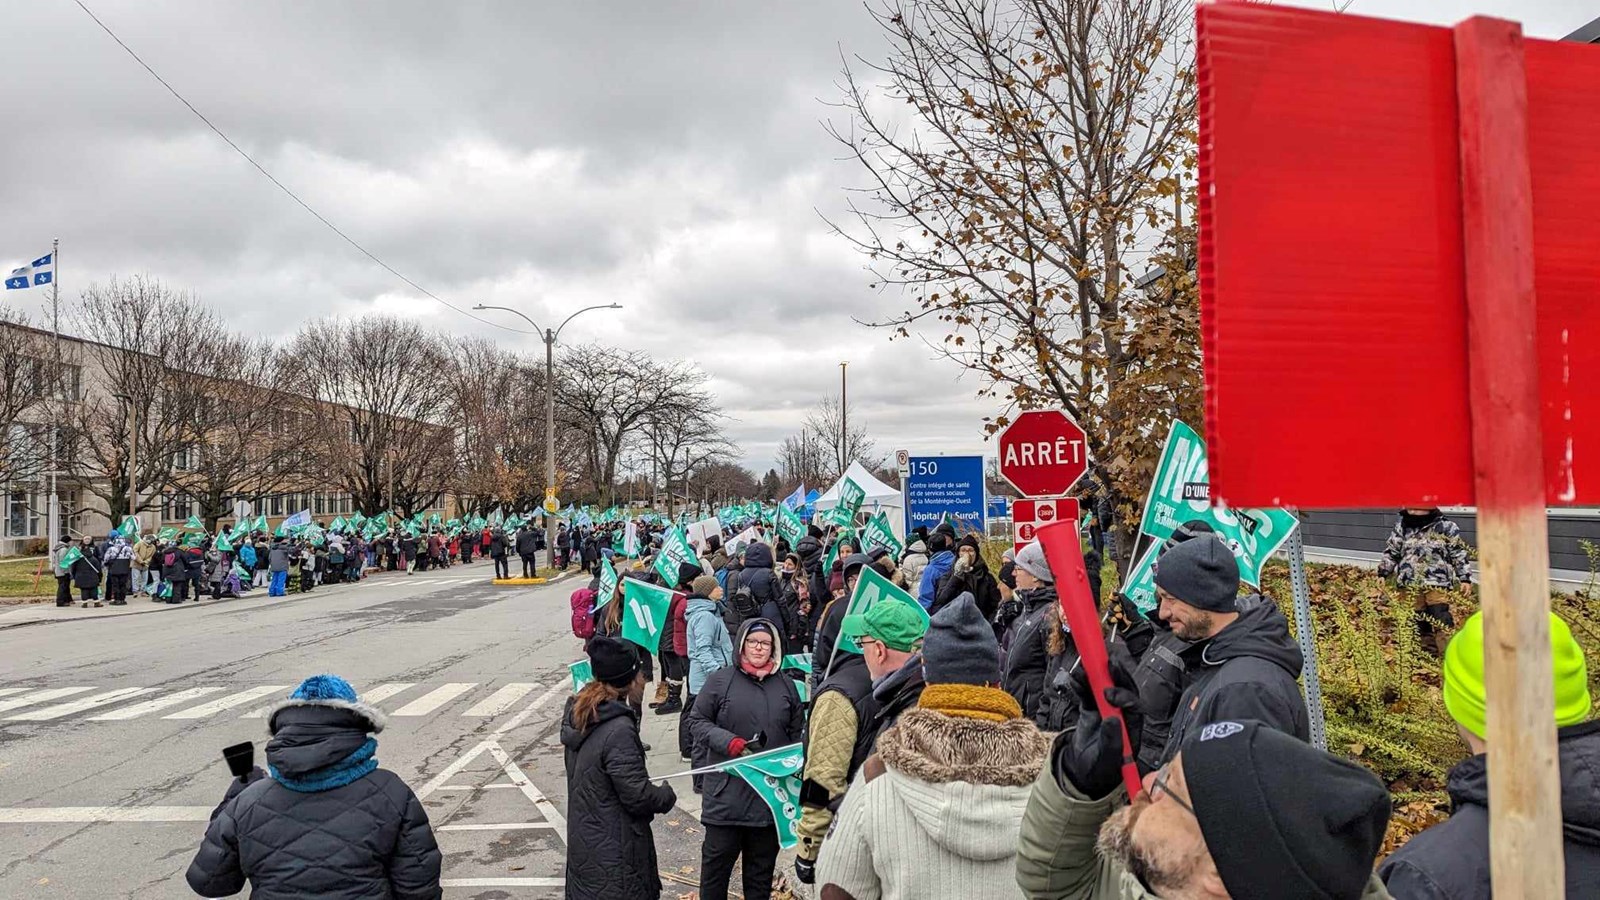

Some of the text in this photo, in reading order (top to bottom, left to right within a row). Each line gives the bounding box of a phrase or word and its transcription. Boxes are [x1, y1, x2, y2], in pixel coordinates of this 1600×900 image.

[1004, 436, 1082, 467] ARRÊT
[910, 461, 938, 476] 150
[928, 481, 946, 490] intégré
[1185, 485, 1209, 498] D'UNE
[924, 497, 971, 506] Montérégie-Ouest
[912, 511, 940, 522] Hôpital
[955, 511, 979, 520] Suroît
